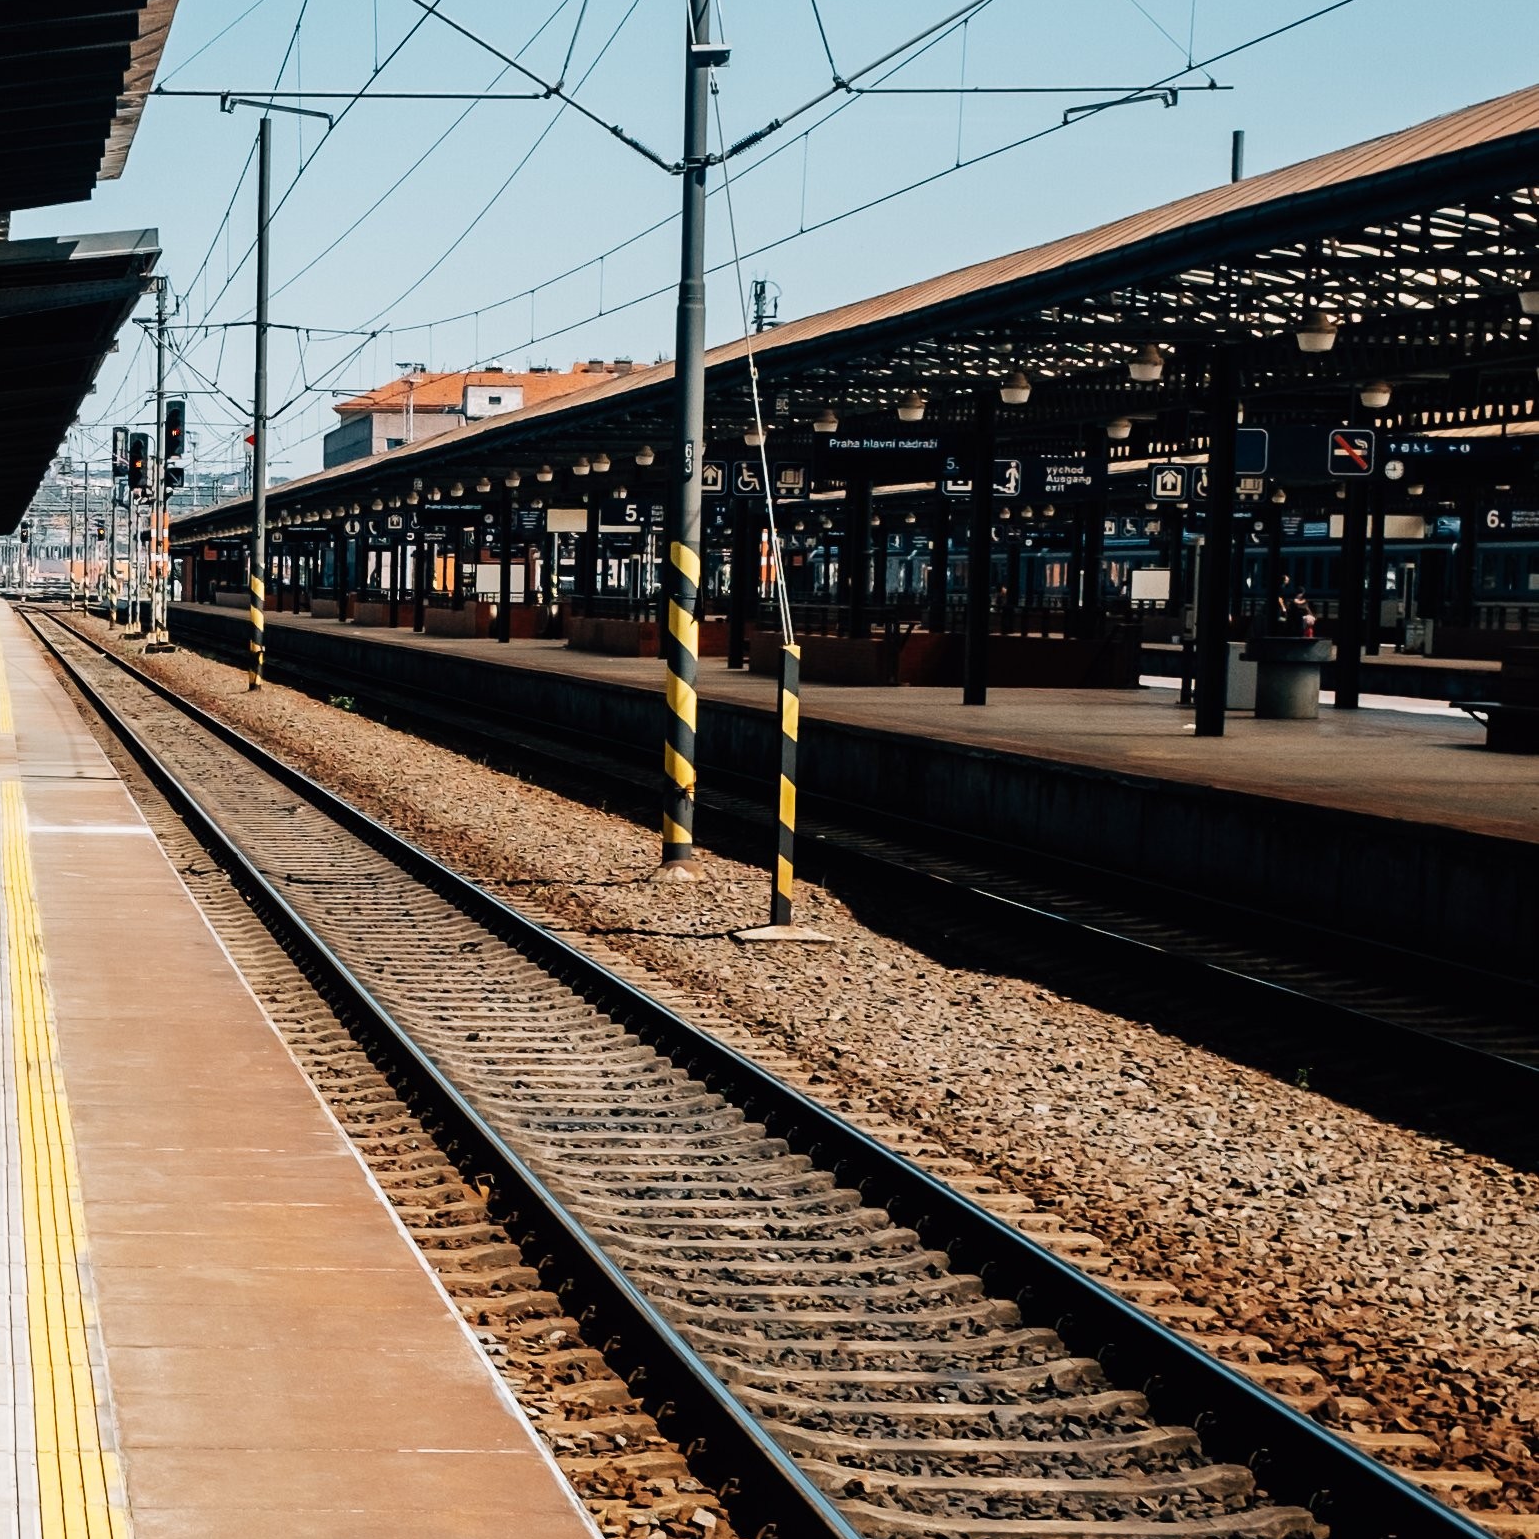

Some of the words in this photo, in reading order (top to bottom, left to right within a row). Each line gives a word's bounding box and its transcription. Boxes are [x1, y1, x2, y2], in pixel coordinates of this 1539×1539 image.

[829, 438, 860, 449] Praha
[863, 438, 896, 449] hlavní
[946, 457, 960, 470] 5.
[1046, 474, 1092, 485] Ausgang
[1045, 483, 1065, 492] exit
[625, 504, 645, 522] 5.
[1486, 509, 1506, 528] 6.
